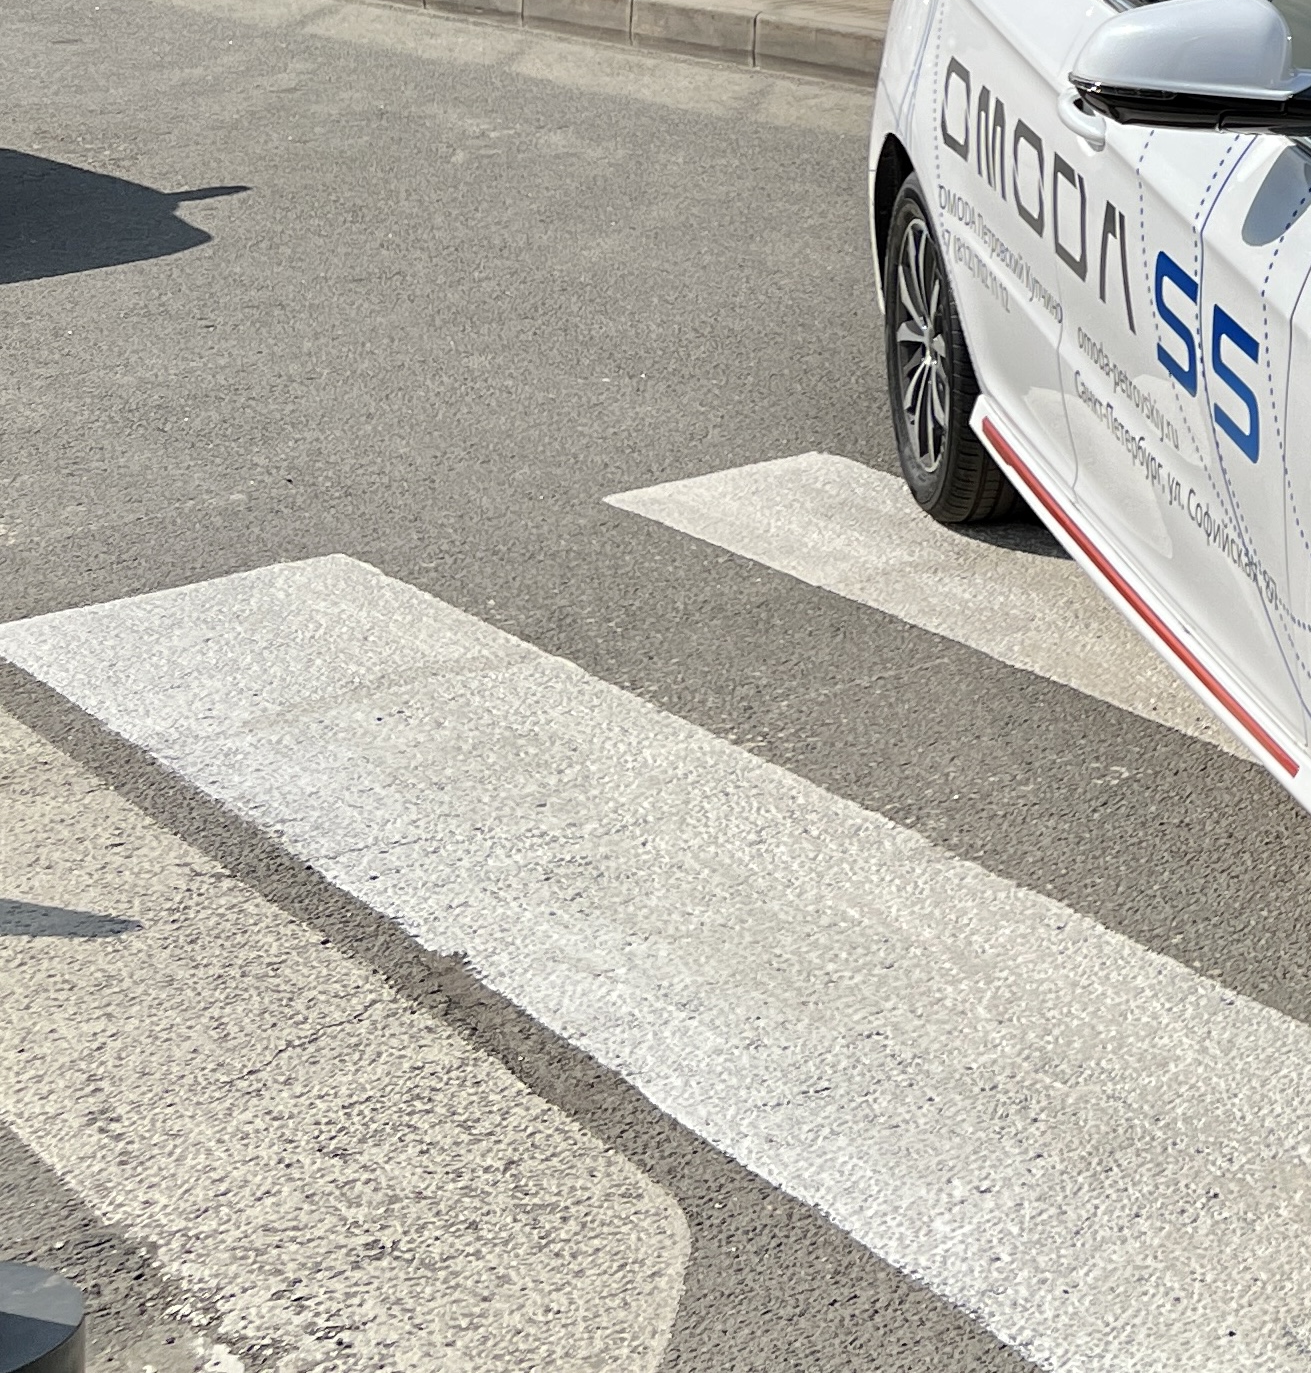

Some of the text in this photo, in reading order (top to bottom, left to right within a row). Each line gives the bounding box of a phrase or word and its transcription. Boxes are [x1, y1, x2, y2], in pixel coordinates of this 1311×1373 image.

[939, 55, 1137, 335] OMODA
[1073, 369, 1166, 494] Санкт-Петербург,
[1167, 470, 1185, 511] ул.
[1077, 326, 1180, 452] omoda-petrovskiy.ru
